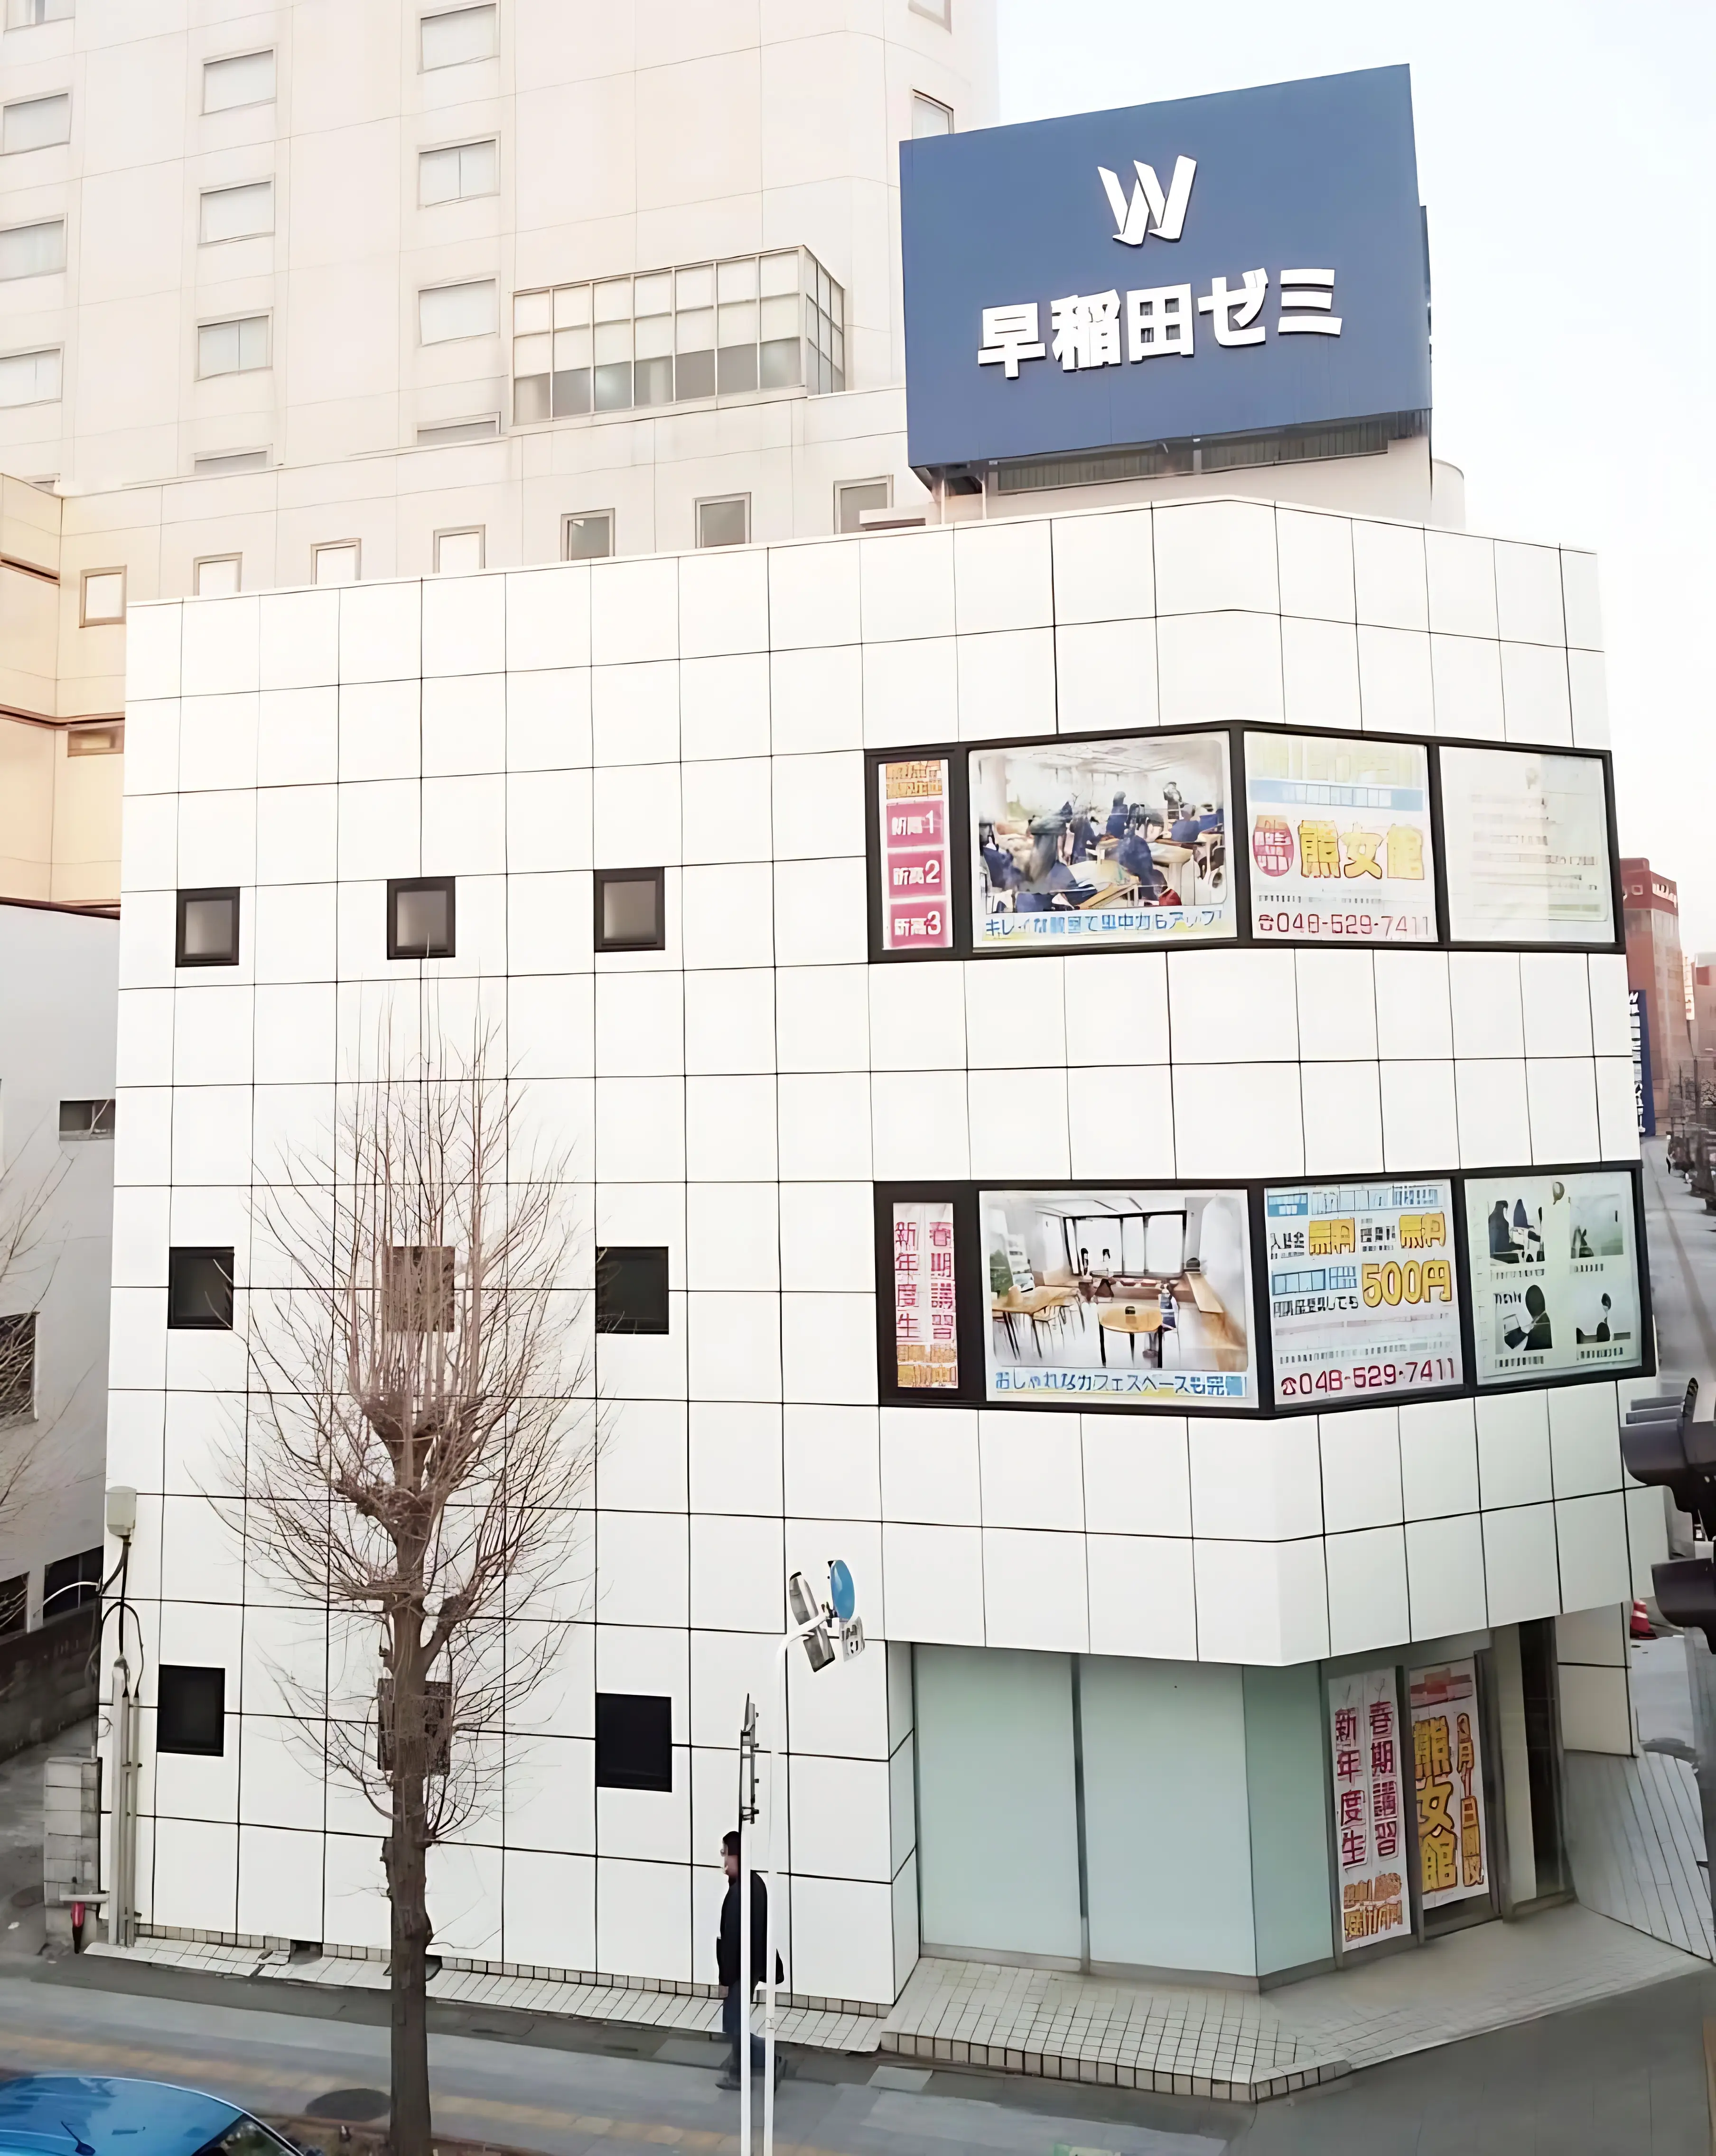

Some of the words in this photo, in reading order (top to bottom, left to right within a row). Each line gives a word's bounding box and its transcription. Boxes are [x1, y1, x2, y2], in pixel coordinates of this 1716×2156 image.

[1097, 155, 1198, 246] W
[978, 267, 1343, 380] 早稲田ゼミ
[1361, 1259, 1452, 1308] 500円
